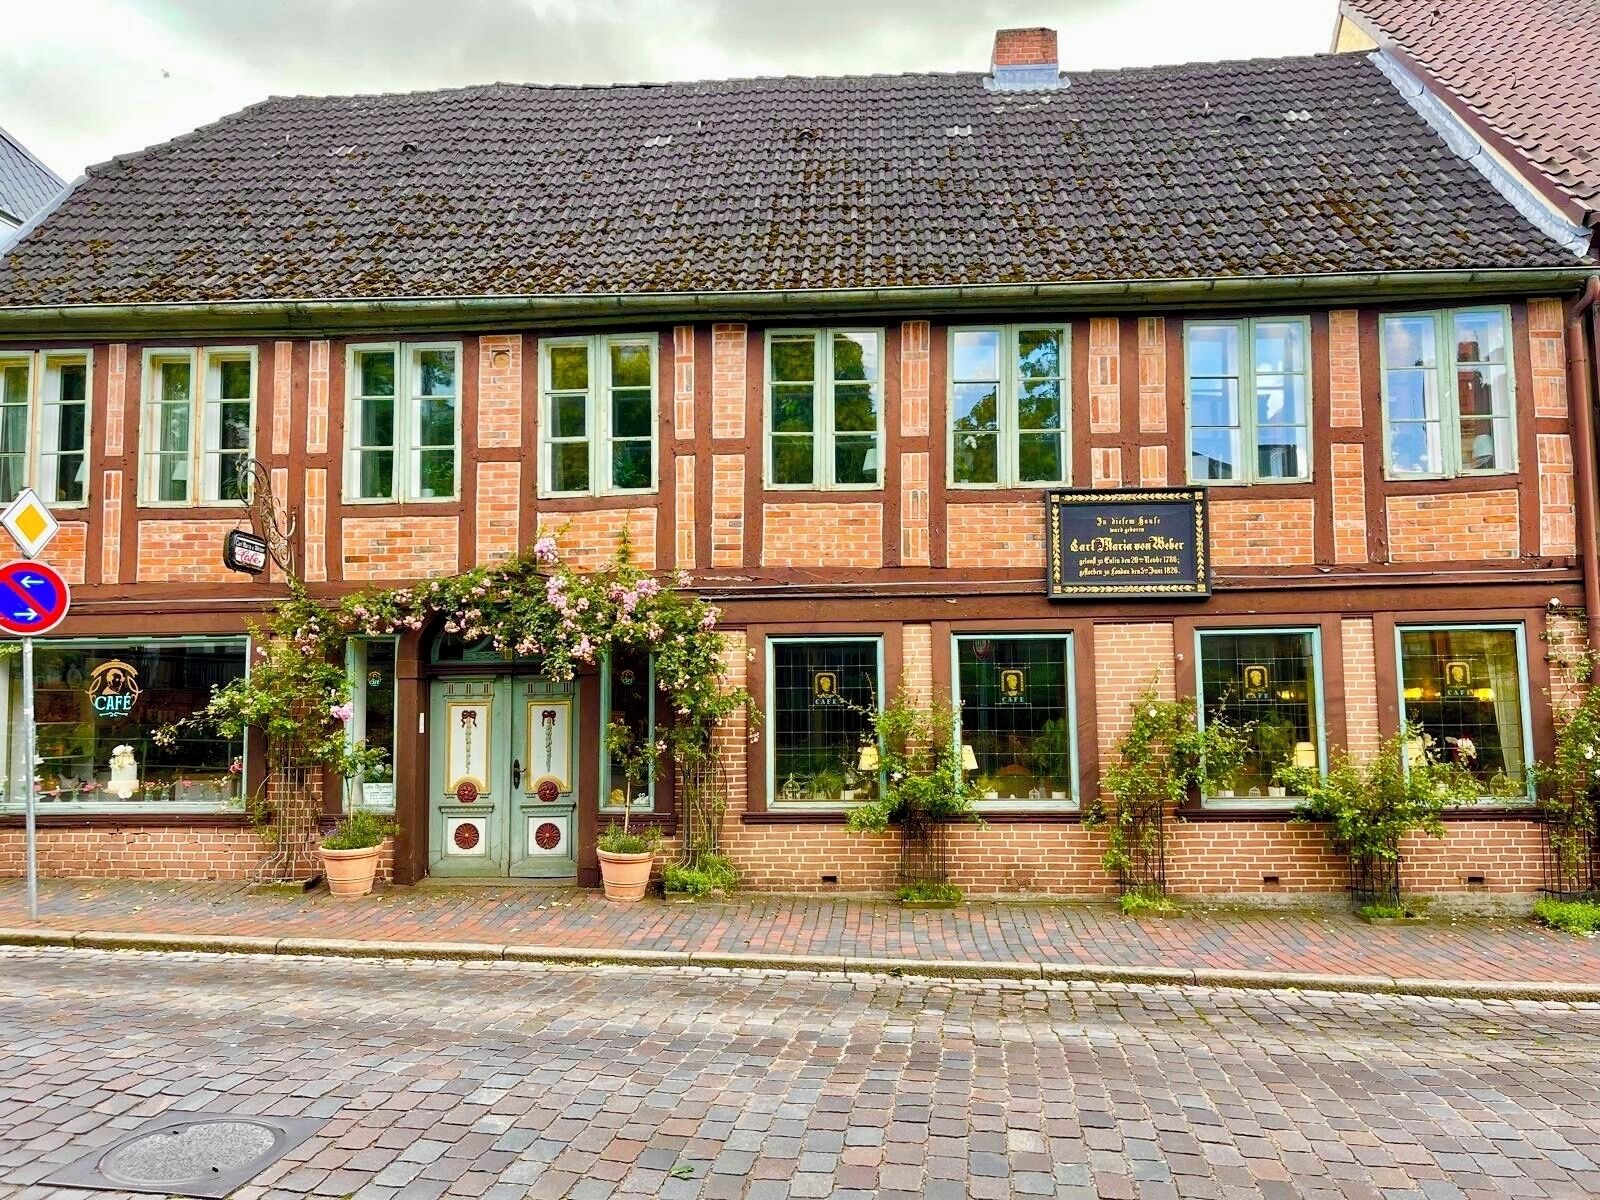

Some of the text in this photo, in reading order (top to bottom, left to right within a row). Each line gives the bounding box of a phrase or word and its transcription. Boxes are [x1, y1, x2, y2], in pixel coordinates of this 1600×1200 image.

[1096, 516, 1107, 527] In
[1070, 535, 1185, 553] Carl Maria von Weber
[1110, 567, 1130, 576] London
[95, 692, 132, 710] CAFÉ
